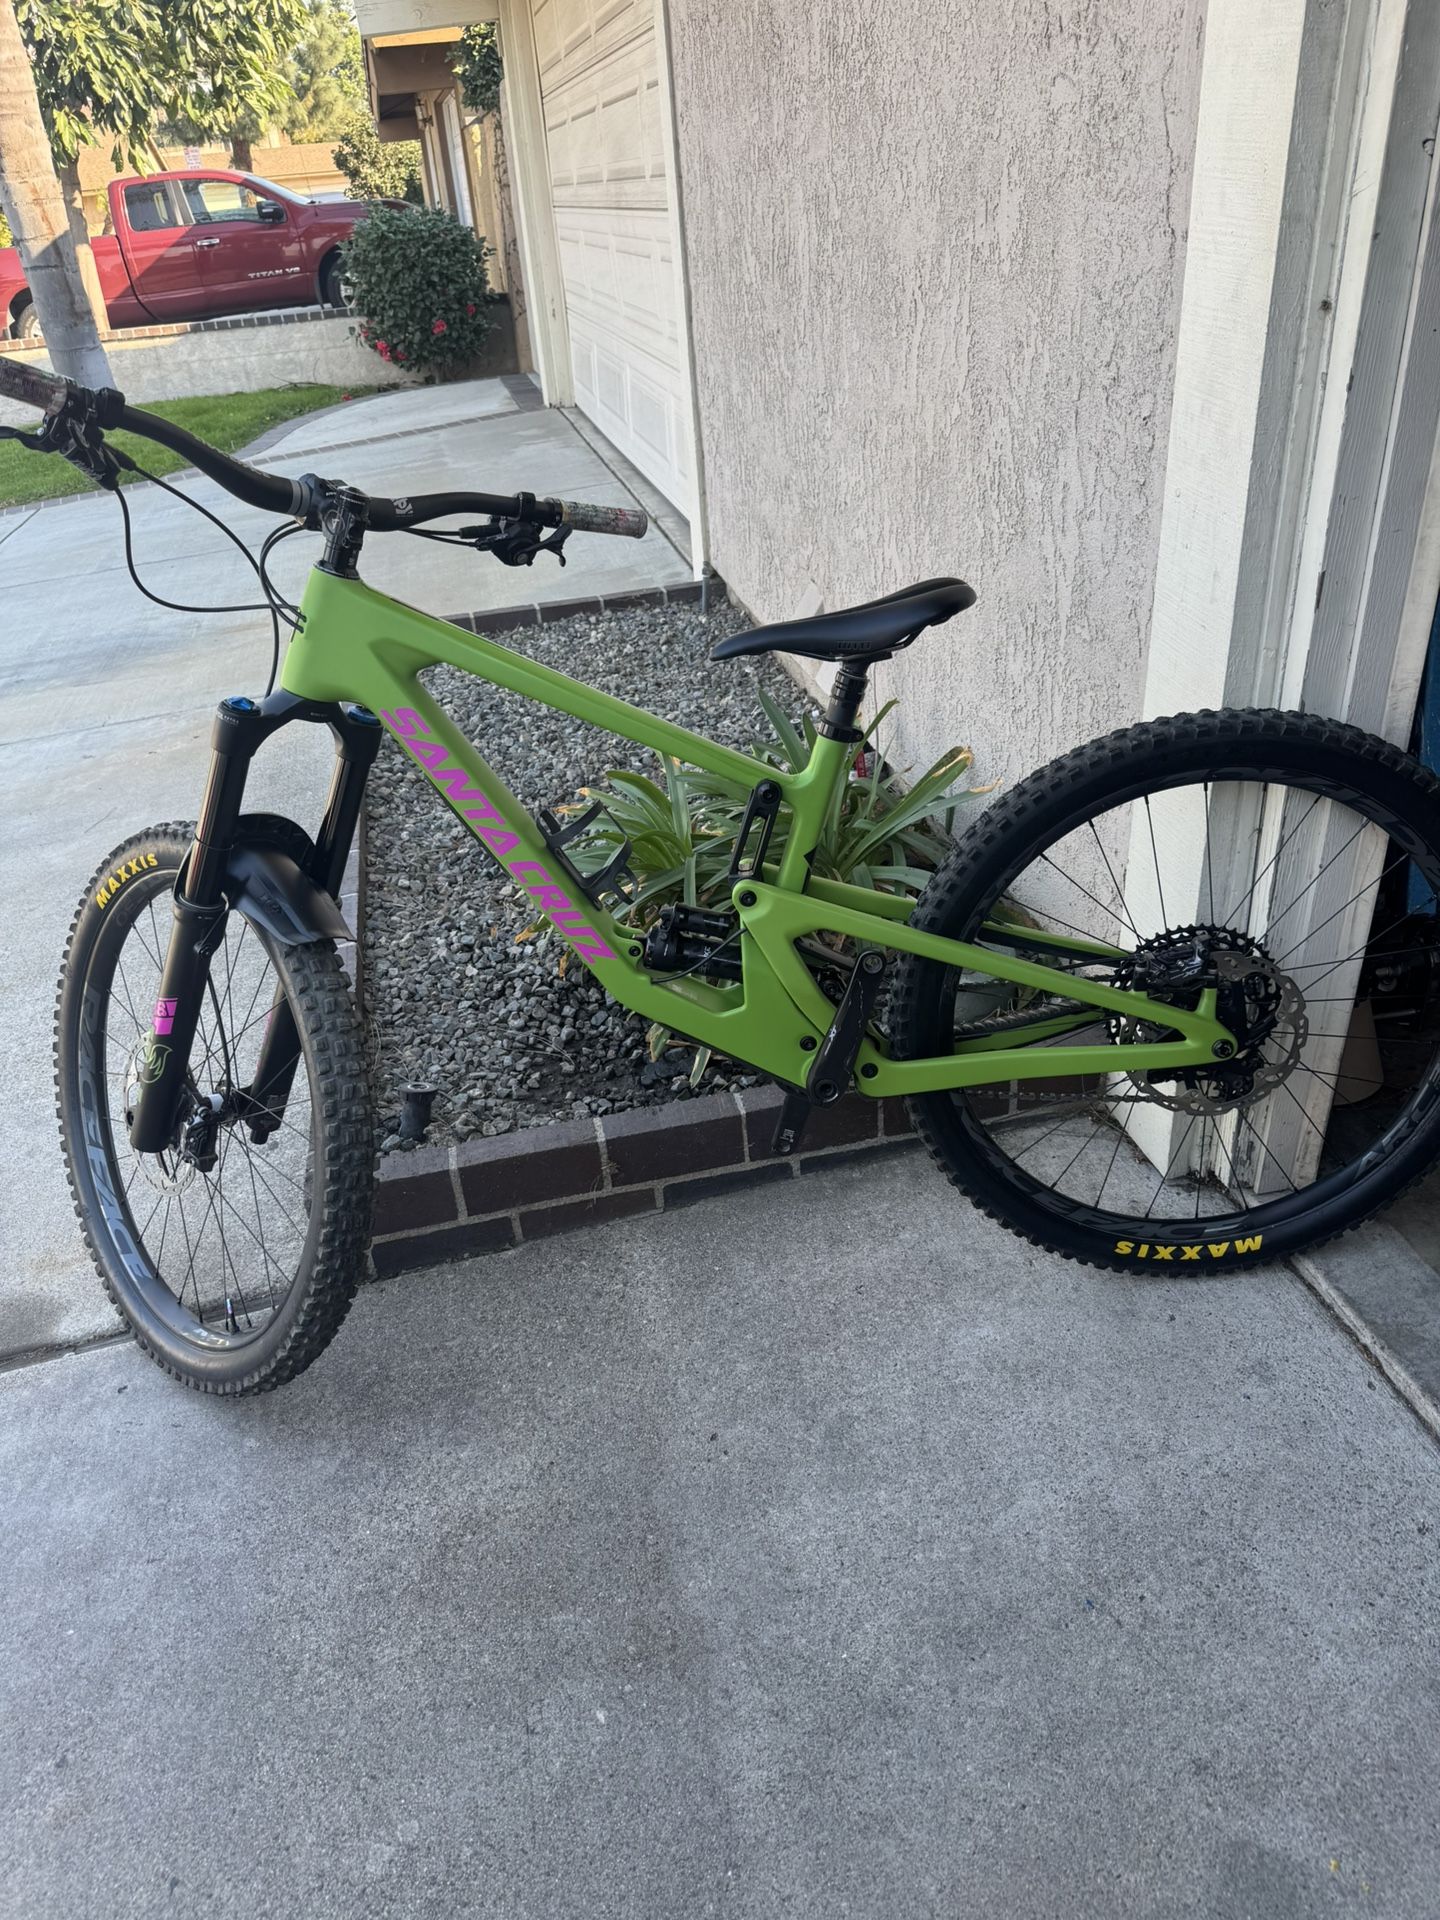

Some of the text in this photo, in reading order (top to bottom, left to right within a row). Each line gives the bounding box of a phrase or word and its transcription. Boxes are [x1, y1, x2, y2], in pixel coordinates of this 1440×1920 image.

[249, 270, 282, 278] TITAN
[380, 707, 617, 965] SANTA CRUZ
[95, 853, 158, 910] MAXXIS
[1113, 1234, 1263, 1260] MAXXIS
